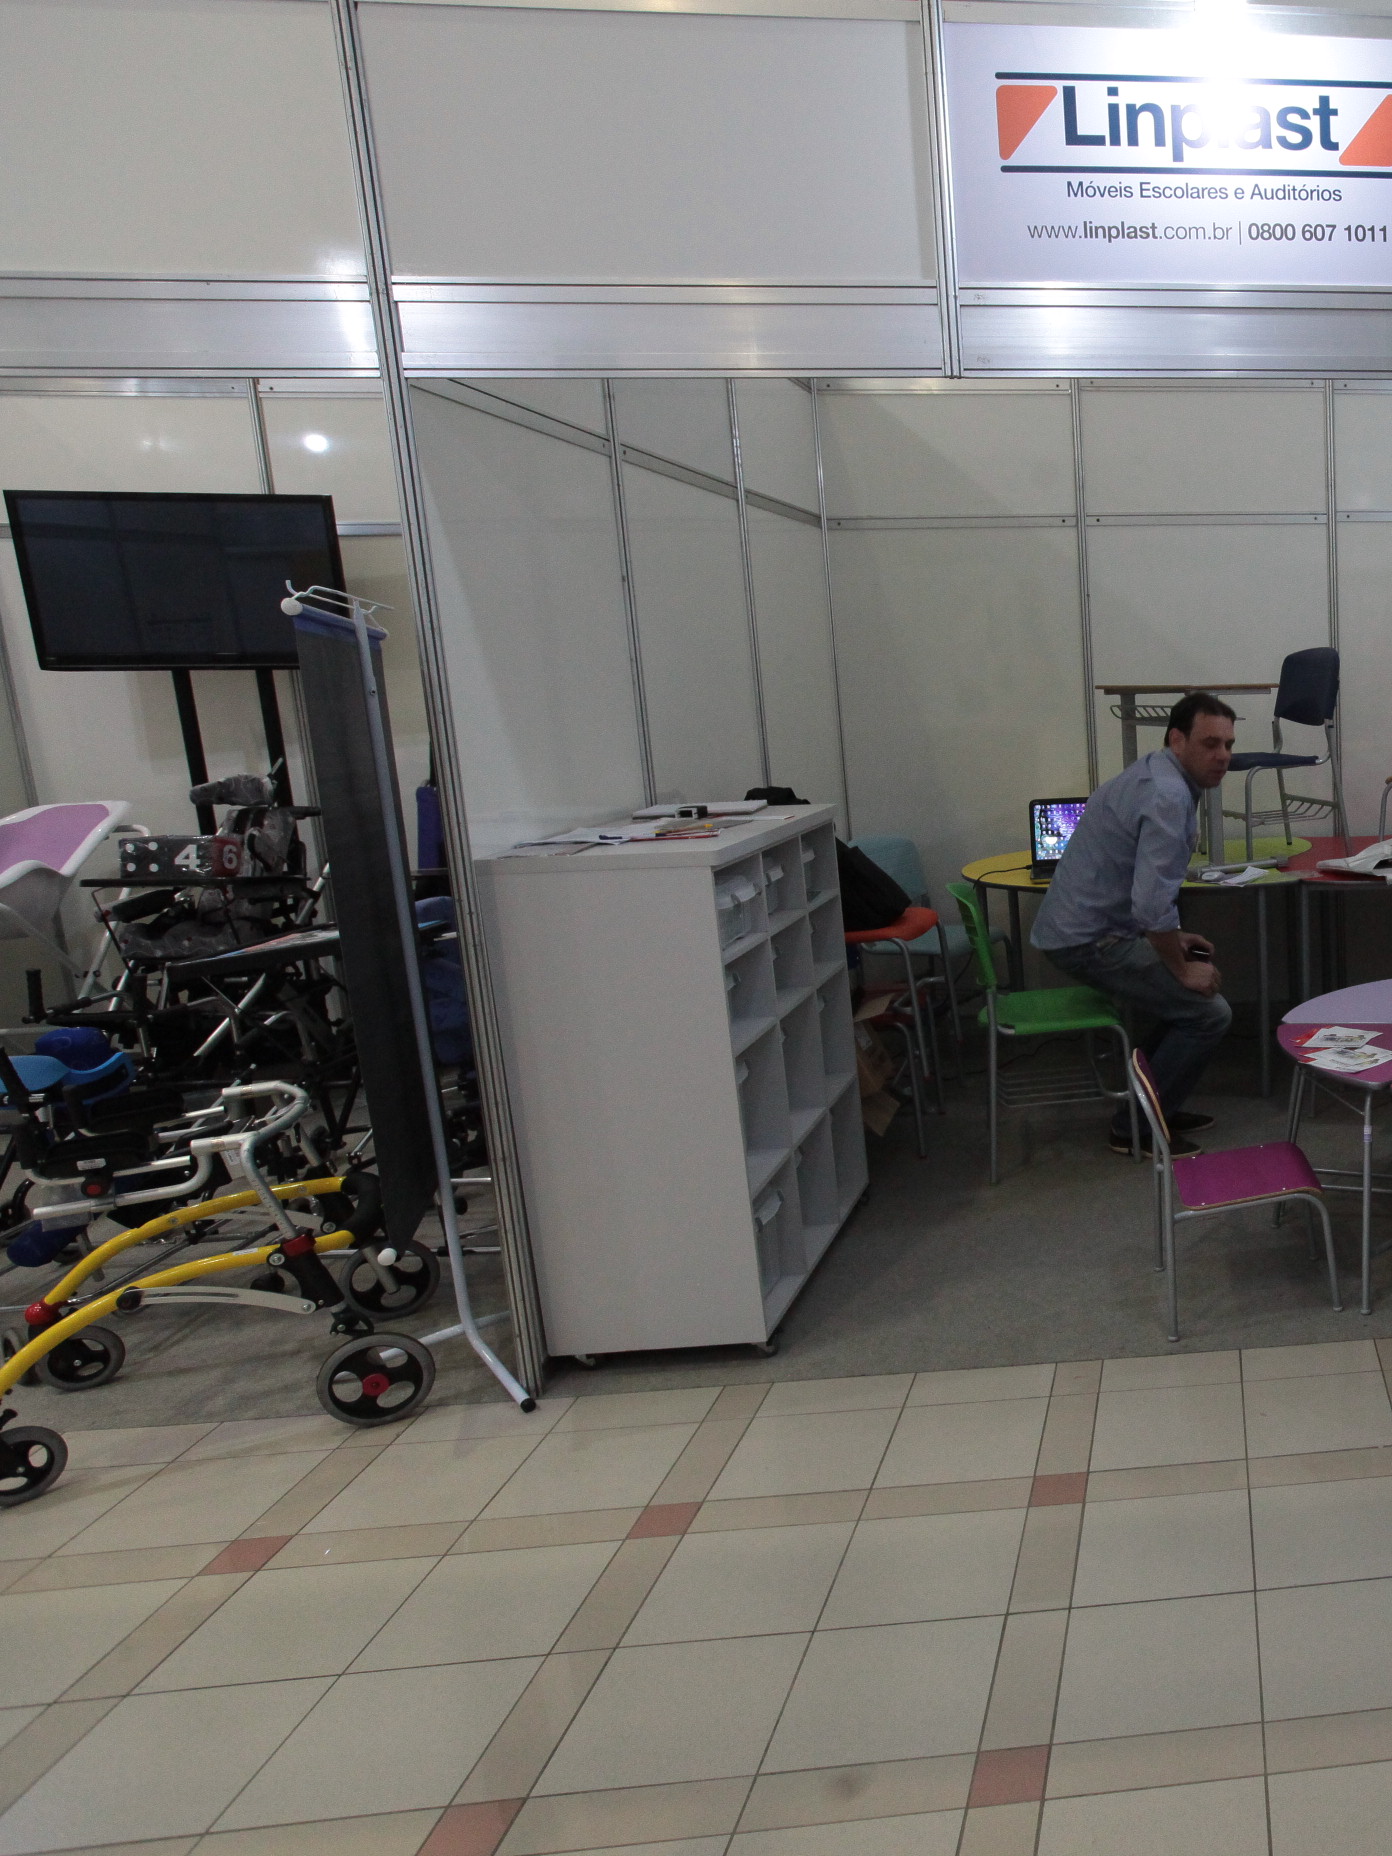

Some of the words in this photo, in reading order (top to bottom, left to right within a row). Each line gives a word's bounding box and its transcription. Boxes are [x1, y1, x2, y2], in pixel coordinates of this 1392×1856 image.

[1063, 86, 1339, 162] Linpast
[1067, 181, 1133, 199] Móveis
[1139, 181, 1229, 200] Escolares
[1234, 188, 1245, 200] e
[1250, 183, 1343, 202] Auditórios
[1027, 220, 1232, 244] www.linplast.com.br
[1248, 222, 1296, 242] 0800
[1301, 223, 1337, 243] 607
[1343, 224, 1389, 243] 1011
[174, 844, 201, 870] 4
[222, 844, 238, 870] 6
